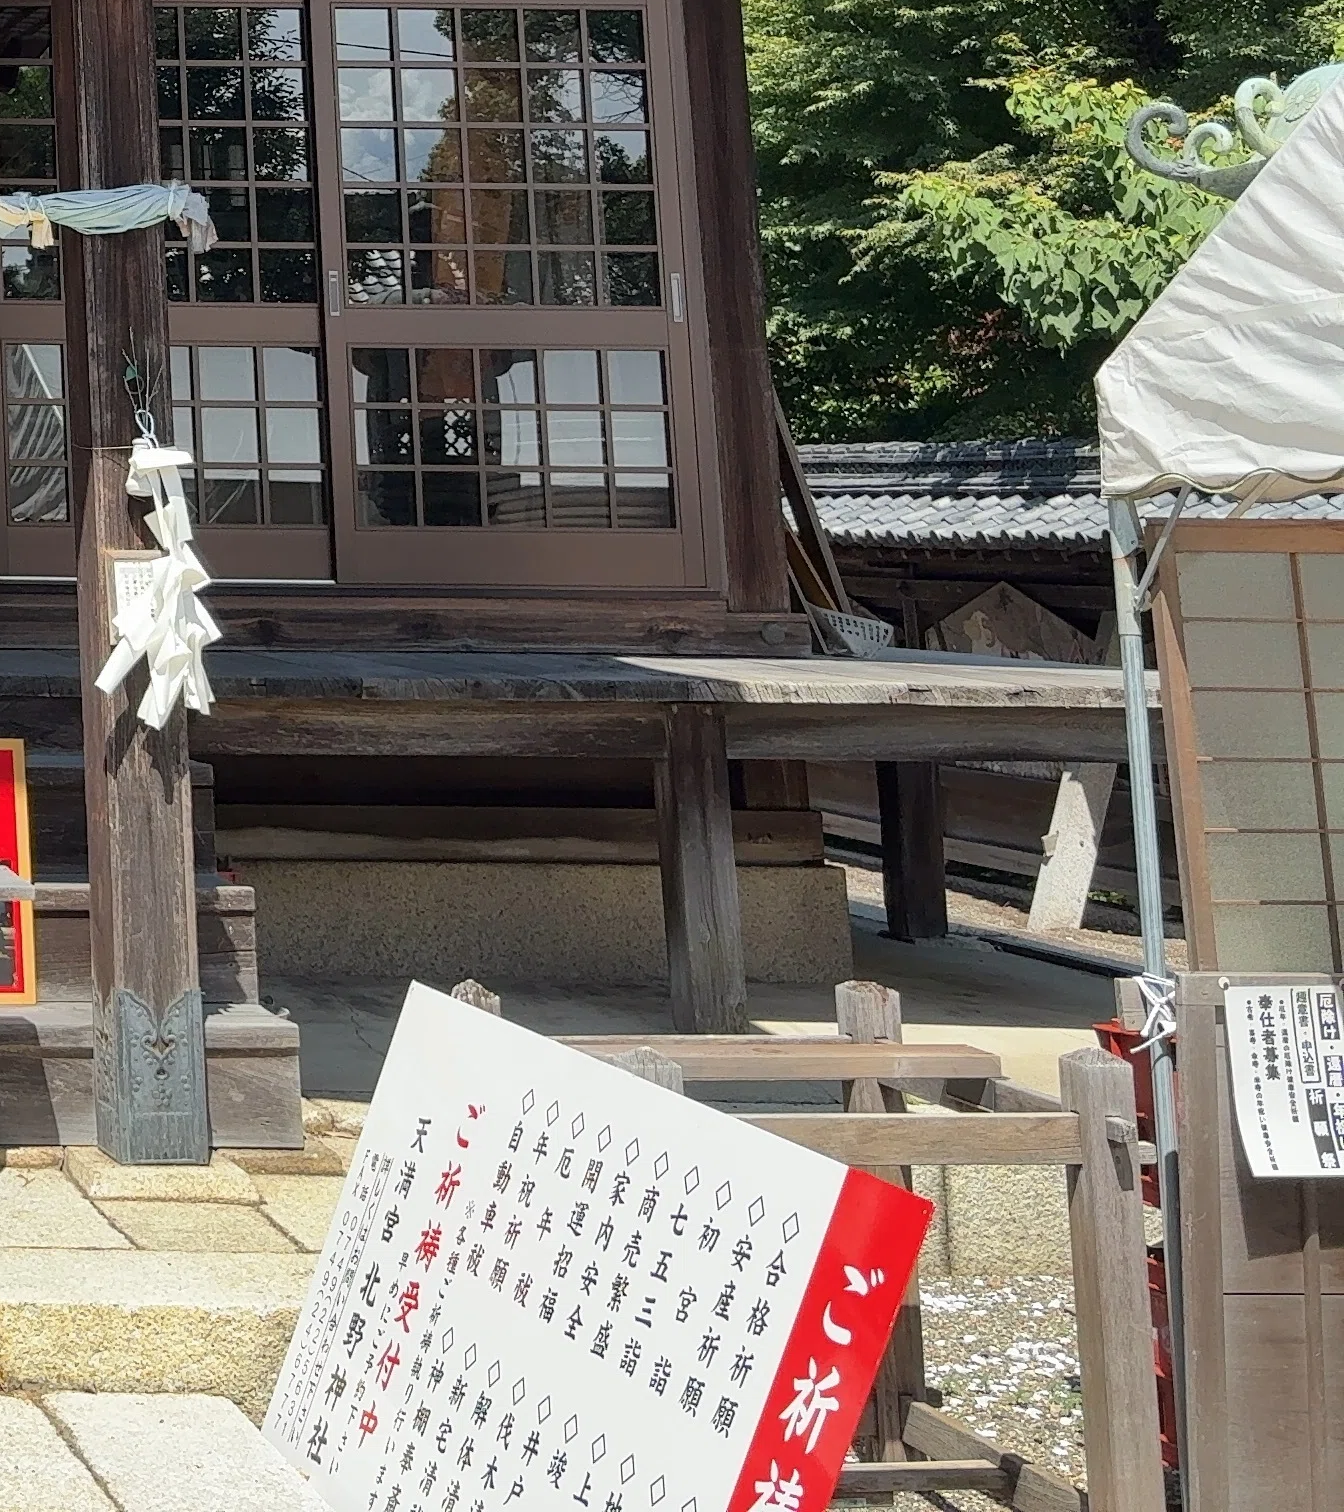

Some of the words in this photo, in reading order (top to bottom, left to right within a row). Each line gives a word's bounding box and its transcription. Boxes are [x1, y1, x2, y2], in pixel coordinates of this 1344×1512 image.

[1257, 994, 1281, 1081] 奉仕者募集
[1296, 991, 1315, 1077] 趣意書・申込書
[358, 1104, 486, 1449] ご祈祷受付中
[467, 1121, 523, 1276] 自動車祓
[490, 1132, 549, 1292] 年祝祈願
[514, 1148, 574, 1307] 厄年祓
[539, 1159, 603, 1323] 開運招福
[565, 1171, 630, 1340] 家内安全
[590, 1186, 659, 1359] 商売繁盛
[330, 1253, 408, 1474] 早めにご予約下さい
[620, 1203, 687, 1377] 七五三詣
[649, 1217, 720, 1396] 初宮詣
[679, 1235, 752, 1417] 安産祈願
[712, 1250, 786, 1438] 合格祈願
[411, 1375, 467, 1512] 新宅清
[503, 1431, 539, 1505] 井戸
[547, 1449, 567, 1489] 竣
